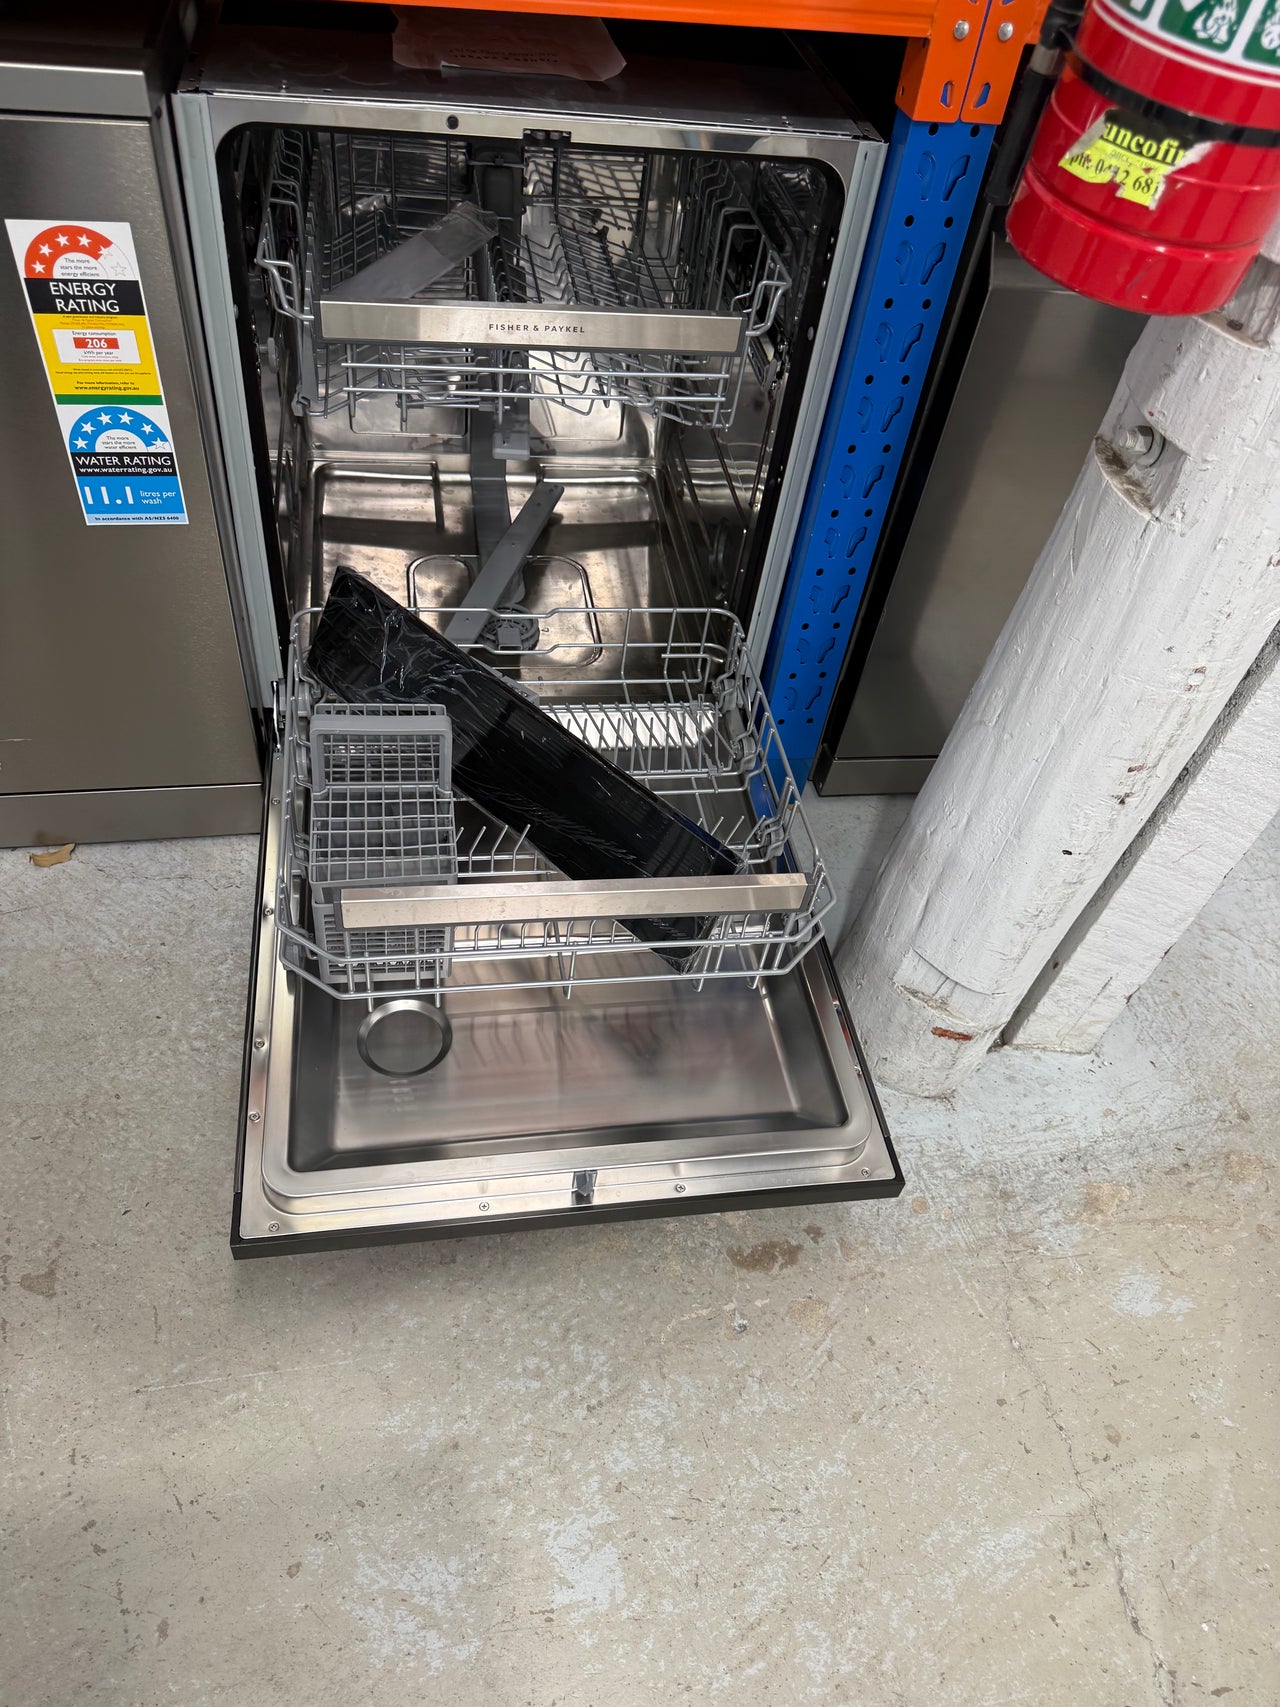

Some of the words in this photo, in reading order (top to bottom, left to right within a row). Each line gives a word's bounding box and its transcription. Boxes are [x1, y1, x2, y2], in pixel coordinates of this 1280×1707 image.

[49, 281, 116, 296] ENERGY
[55, 298, 120, 313] RATING
[488, 323, 529, 331] FISHER
[544, 325, 585, 333] PAYKEL
[85, 338, 108, 348] 206
[75, 456, 120, 466] WATER
[124, 456, 171, 466] RATING
[79, 466, 172, 474] www.waterrating.gov.au
[84, 486, 134, 505] 11.1
[140, 490, 160, 498] litres
[162, 491, 176, 499] per
